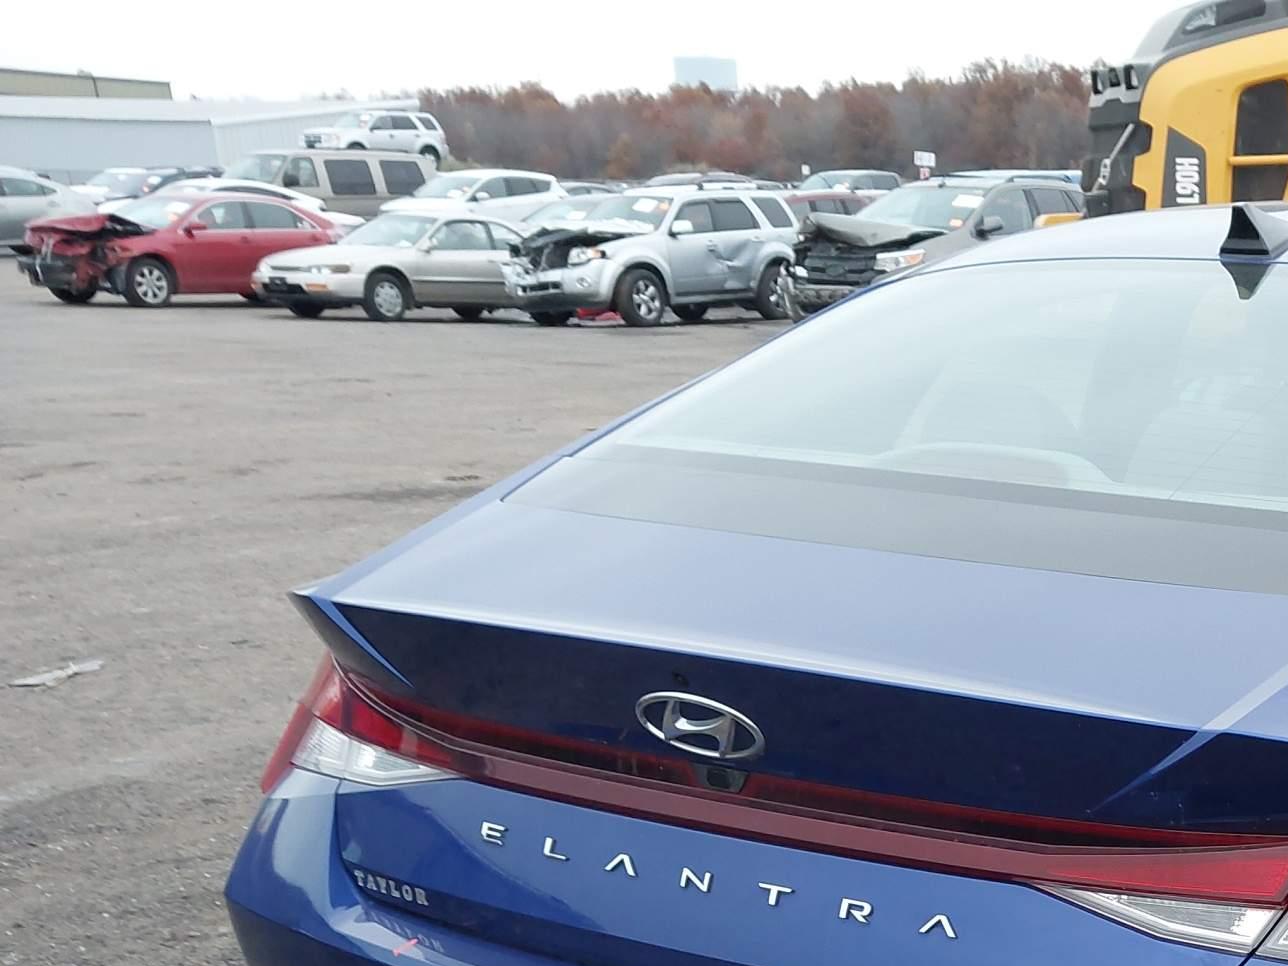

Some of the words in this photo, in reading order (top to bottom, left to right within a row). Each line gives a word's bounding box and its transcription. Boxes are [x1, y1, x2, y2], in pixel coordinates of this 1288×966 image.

[1175, 157, 1200, 204] L90H
[353, 869, 429, 906] TAYLOR
[480, 821, 958, 939] ELANTRA
